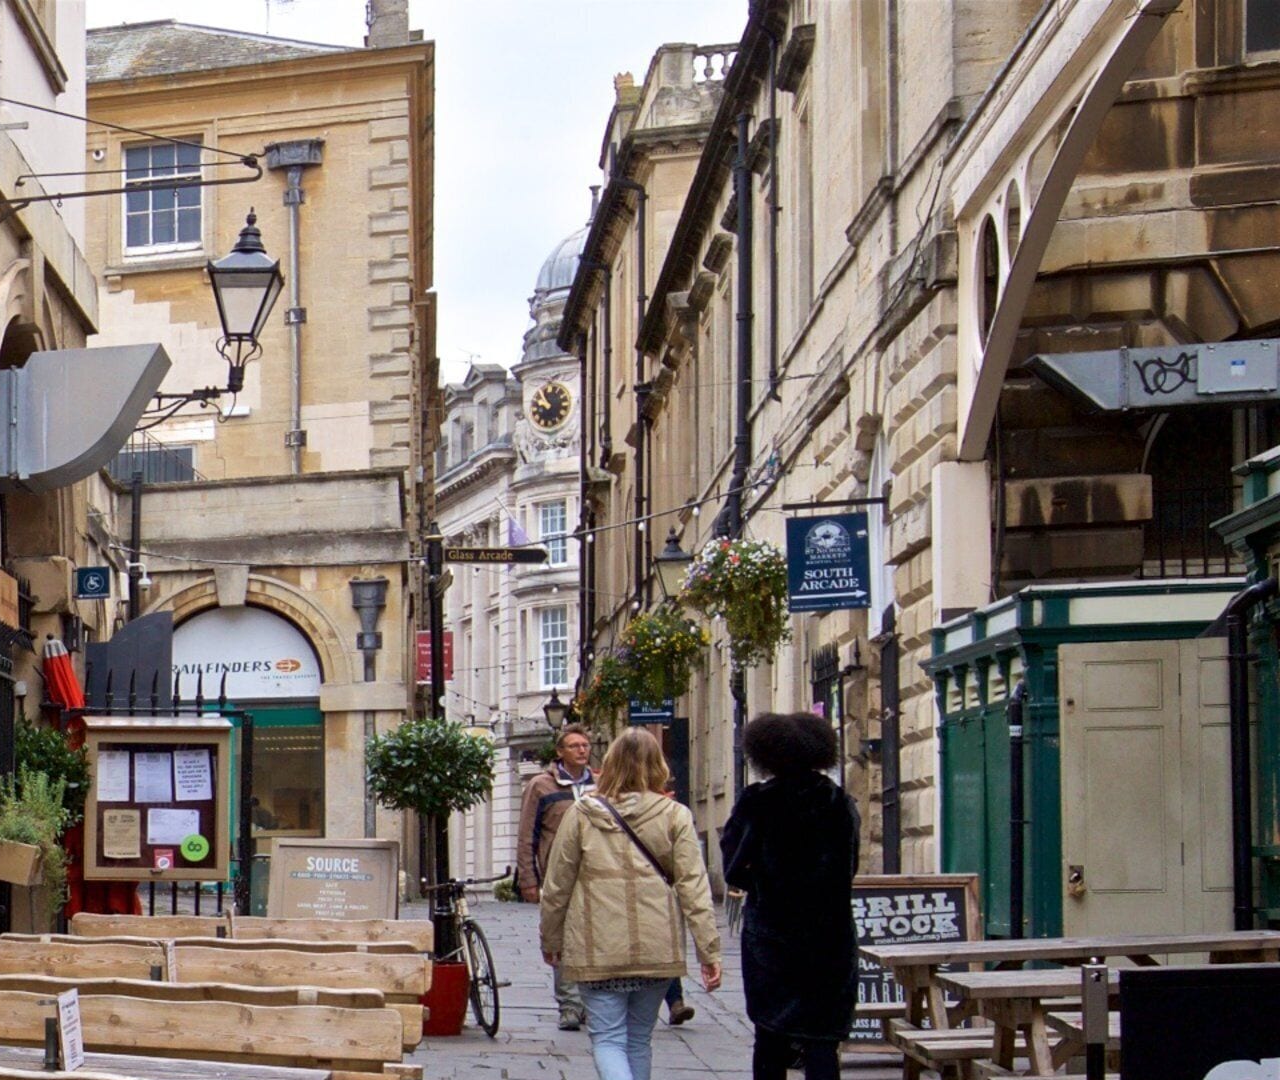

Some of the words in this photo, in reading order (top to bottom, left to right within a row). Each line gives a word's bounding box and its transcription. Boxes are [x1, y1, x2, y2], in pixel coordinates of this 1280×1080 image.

[448, 550, 474, 560] Glass
[478, 550, 514, 560] Arcade
[804, 567, 853, 579] SOUTH
[800, 578, 859, 591] ARCADE
[172, 661, 272, 675] RAILFINDERS
[306, 856, 359, 873] SOURCE
